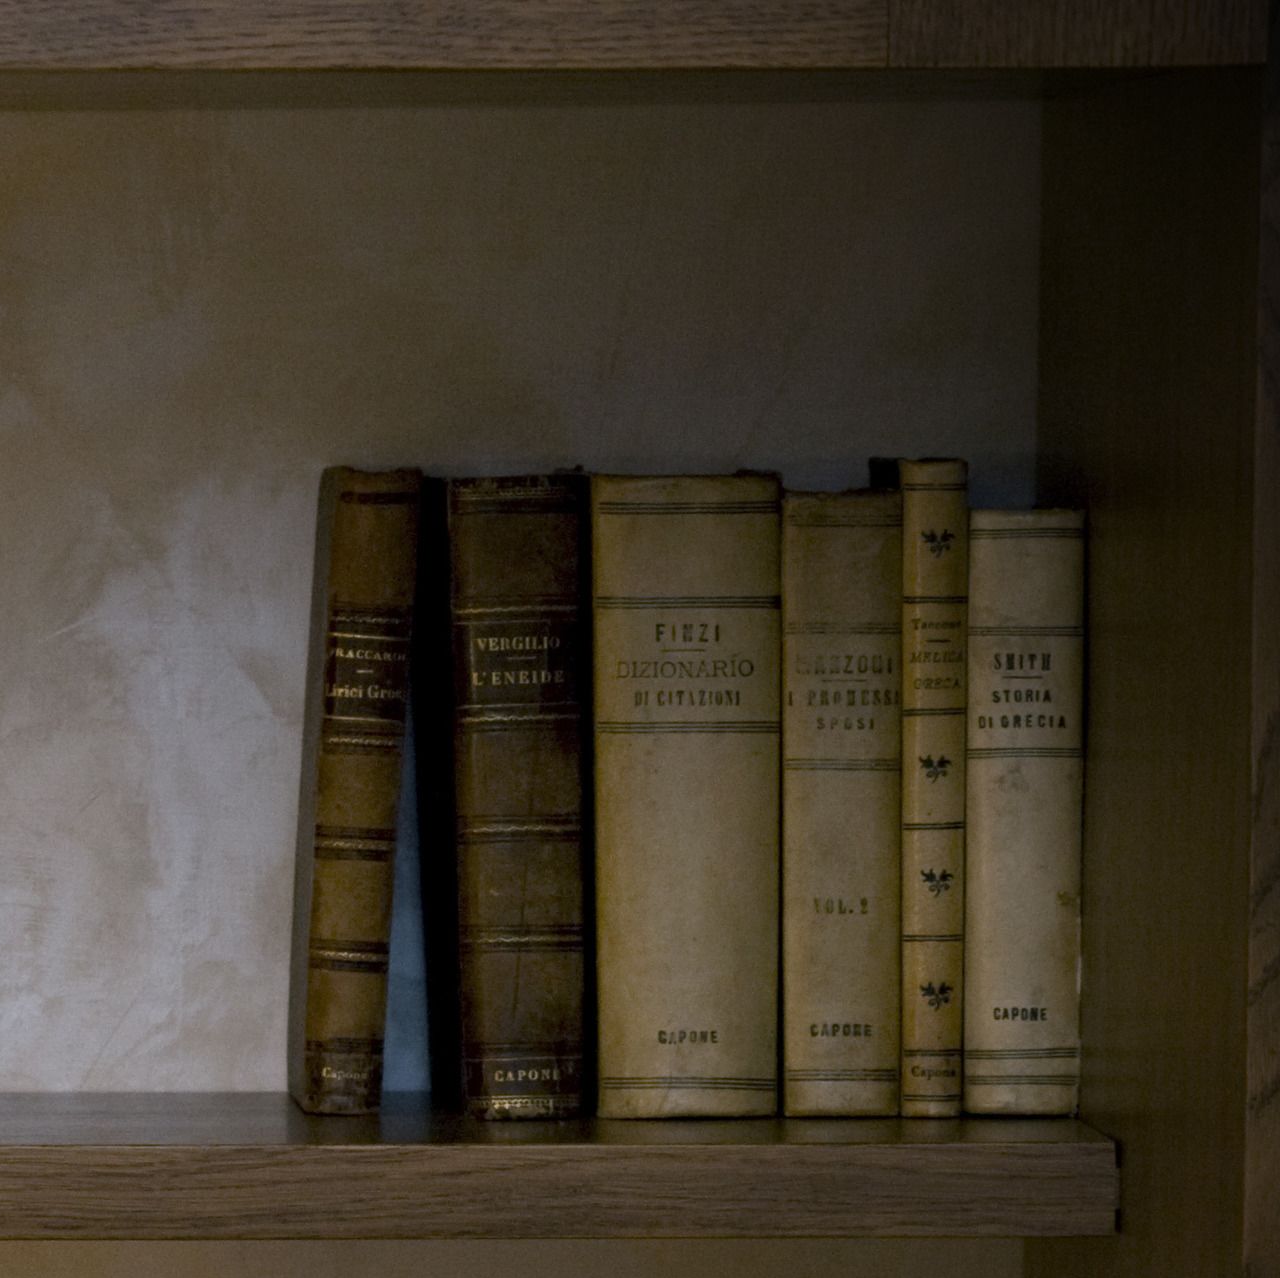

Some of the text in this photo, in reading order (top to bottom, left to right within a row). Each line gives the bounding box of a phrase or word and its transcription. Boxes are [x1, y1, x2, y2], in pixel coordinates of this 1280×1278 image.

[655, 623, 720, 643] FINZI
[476, 635, 561, 652] VERGILIO
[993, 652, 1052, 671] SMITH
[471, 670, 565, 687] L'ENEIDE
[634, 690, 741, 707] DI CITAZIONI
[992, 689, 1052, 703] STORIA
[816, 717, 875, 730] SPOSI
[978, 714, 1066, 729] DI GRECIA
[813, 897, 854, 914] VOL.
[993, 1007, 1048, 1021] CAPONE
[657, 1030, 719, 1044] CAPONE
[810, 1023, 873, 1037] CAPONE
[493, 1068, 560, 1083] CAPONE
[910, 1066, 956, 1080] Capone
